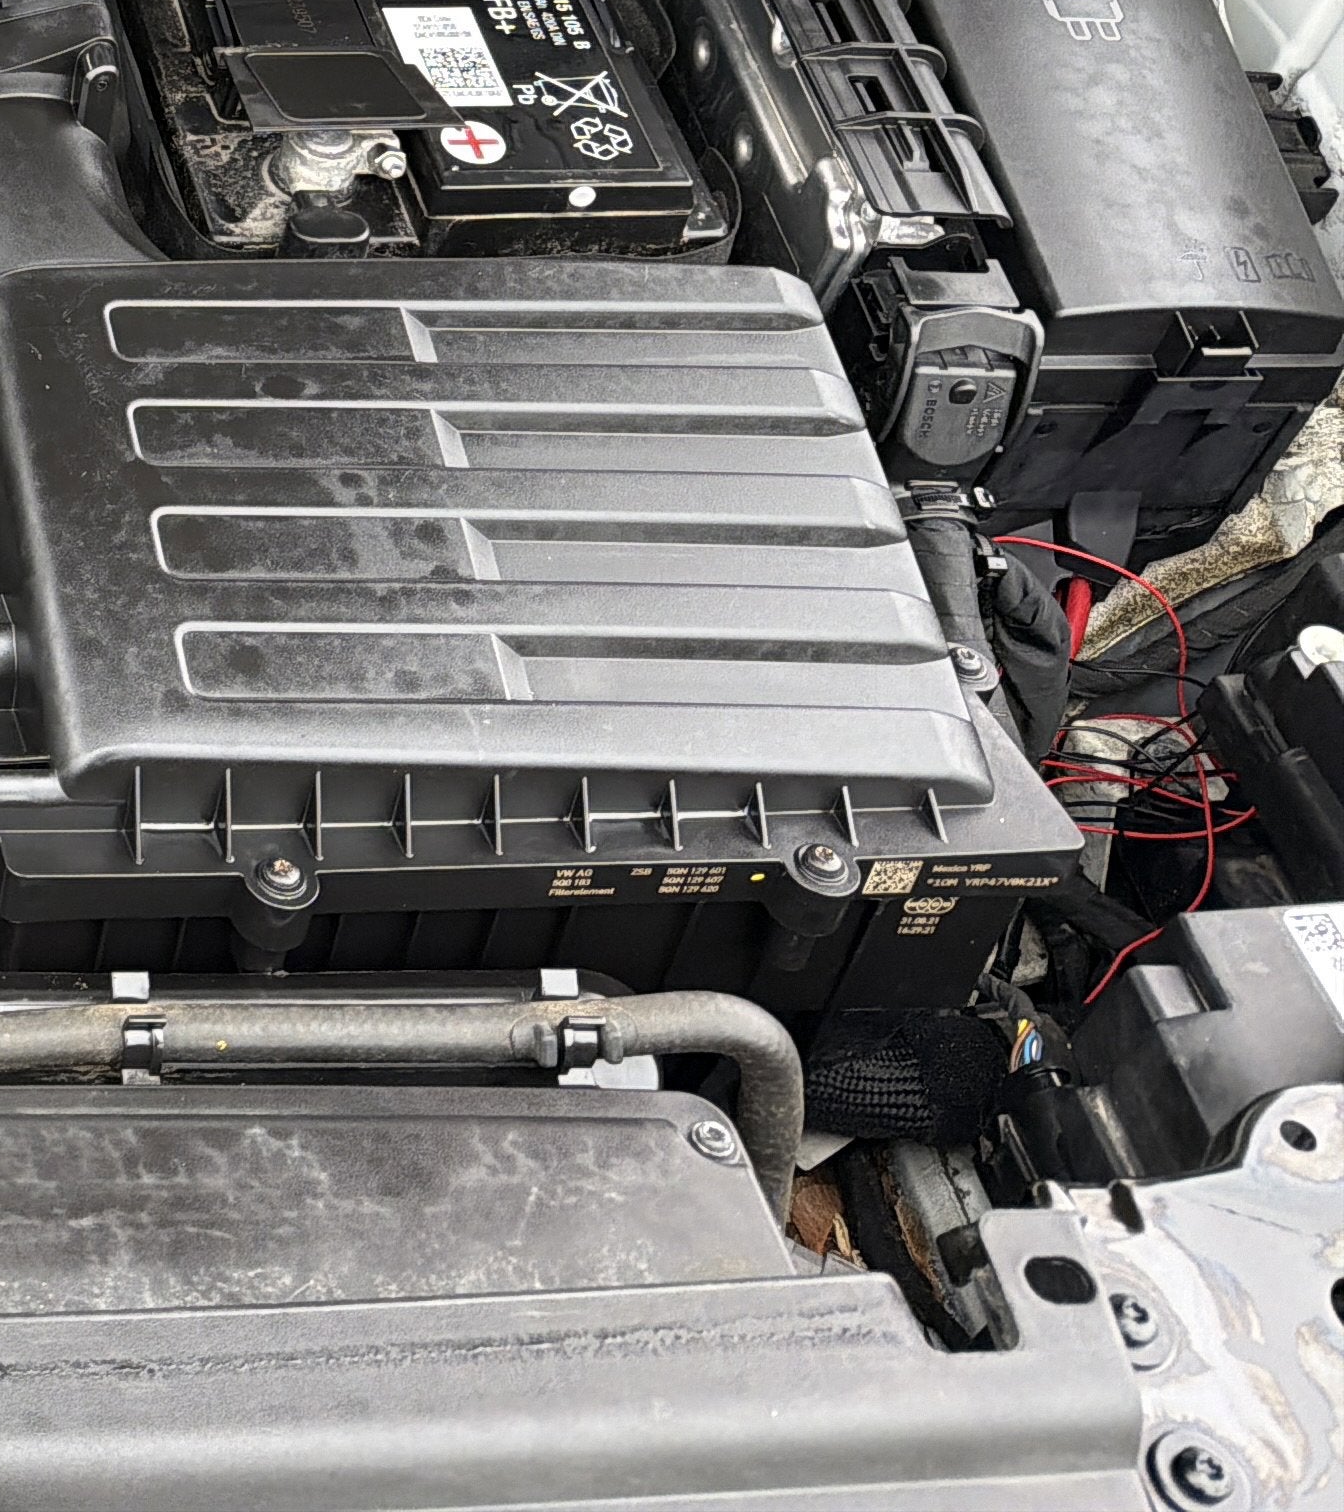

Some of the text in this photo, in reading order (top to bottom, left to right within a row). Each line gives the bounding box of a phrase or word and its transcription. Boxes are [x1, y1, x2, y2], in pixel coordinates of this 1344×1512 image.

[561, 13, 584, 36] 105
[573, 40, 591, 50] B
[512, 84, 538, 105] Pb
[918, 398, 937, 438] BOSCH
[556, 868, 592, 877] VW AG
[709, 866, 726, 874] 601
[932, 863, 991, 874] Mexico YRP
[705, 875, 723, 883] 607
[548, 887, 614, 896] Filterelement
